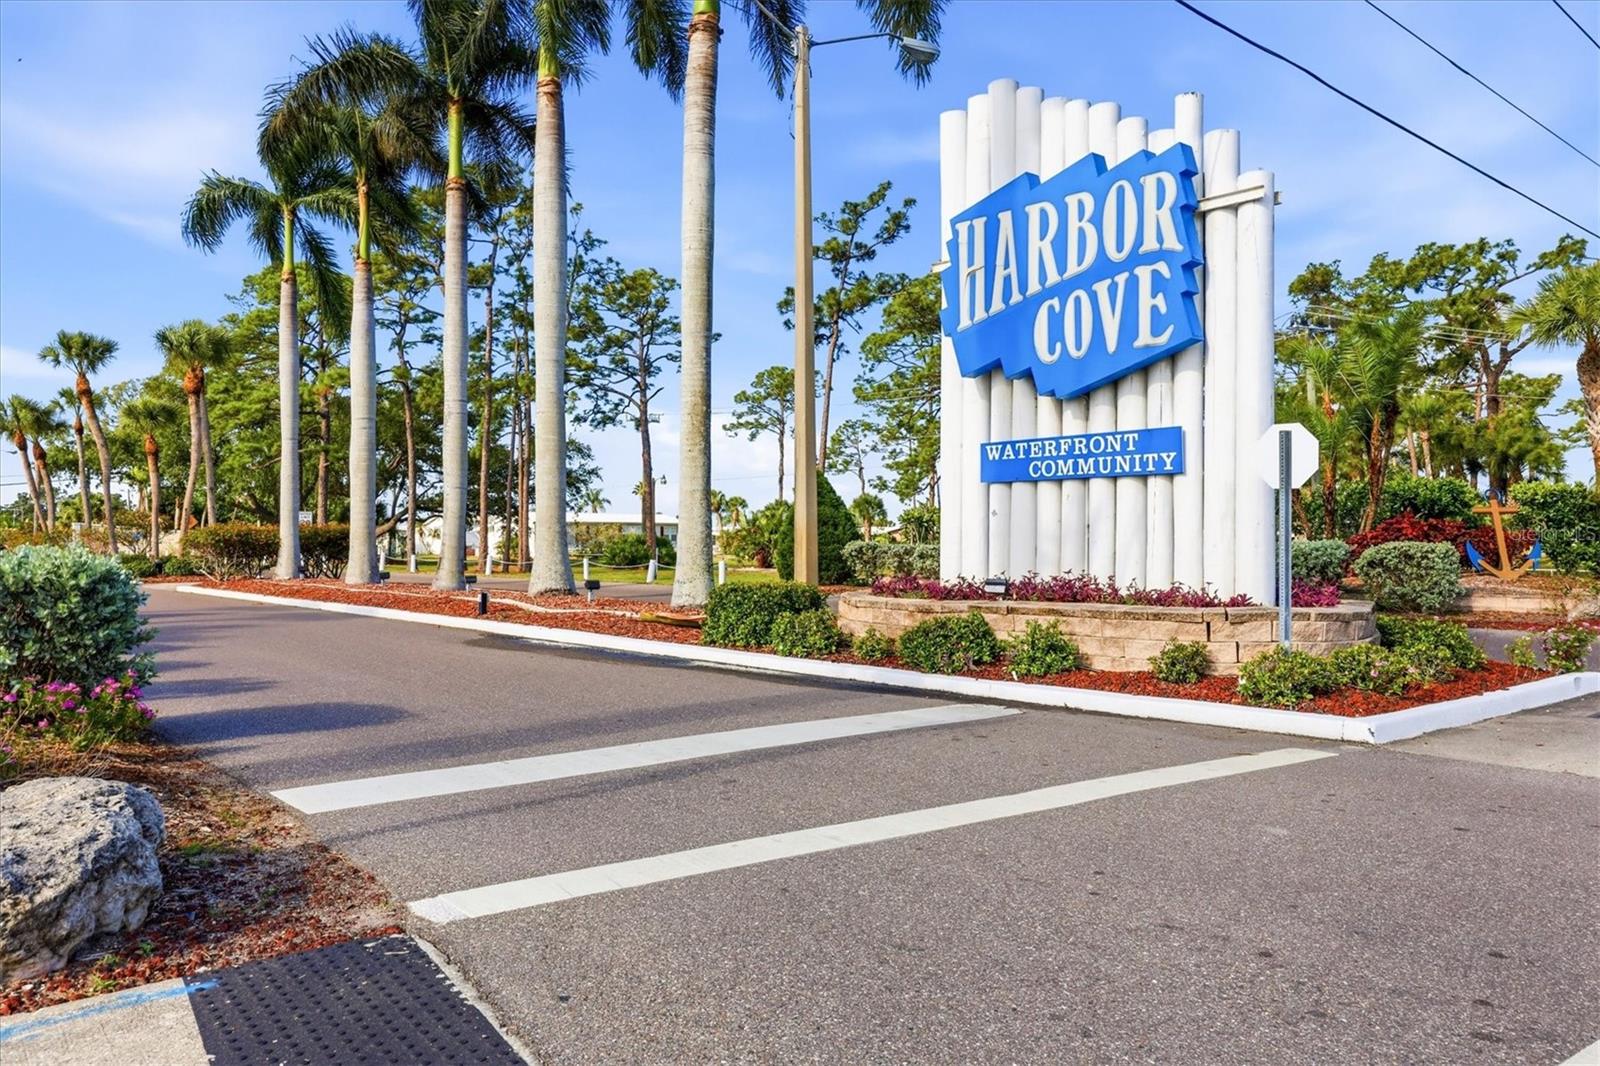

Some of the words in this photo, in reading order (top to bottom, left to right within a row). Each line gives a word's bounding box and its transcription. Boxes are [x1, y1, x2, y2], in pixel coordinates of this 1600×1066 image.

[955, 171, 1184, 332] HARBOR
[1033, 261, 1175, 364] COVE
[985, 433, 1139, 461] WATERFRONT
[1028, 452, 1177, 478] COMMUNITY
